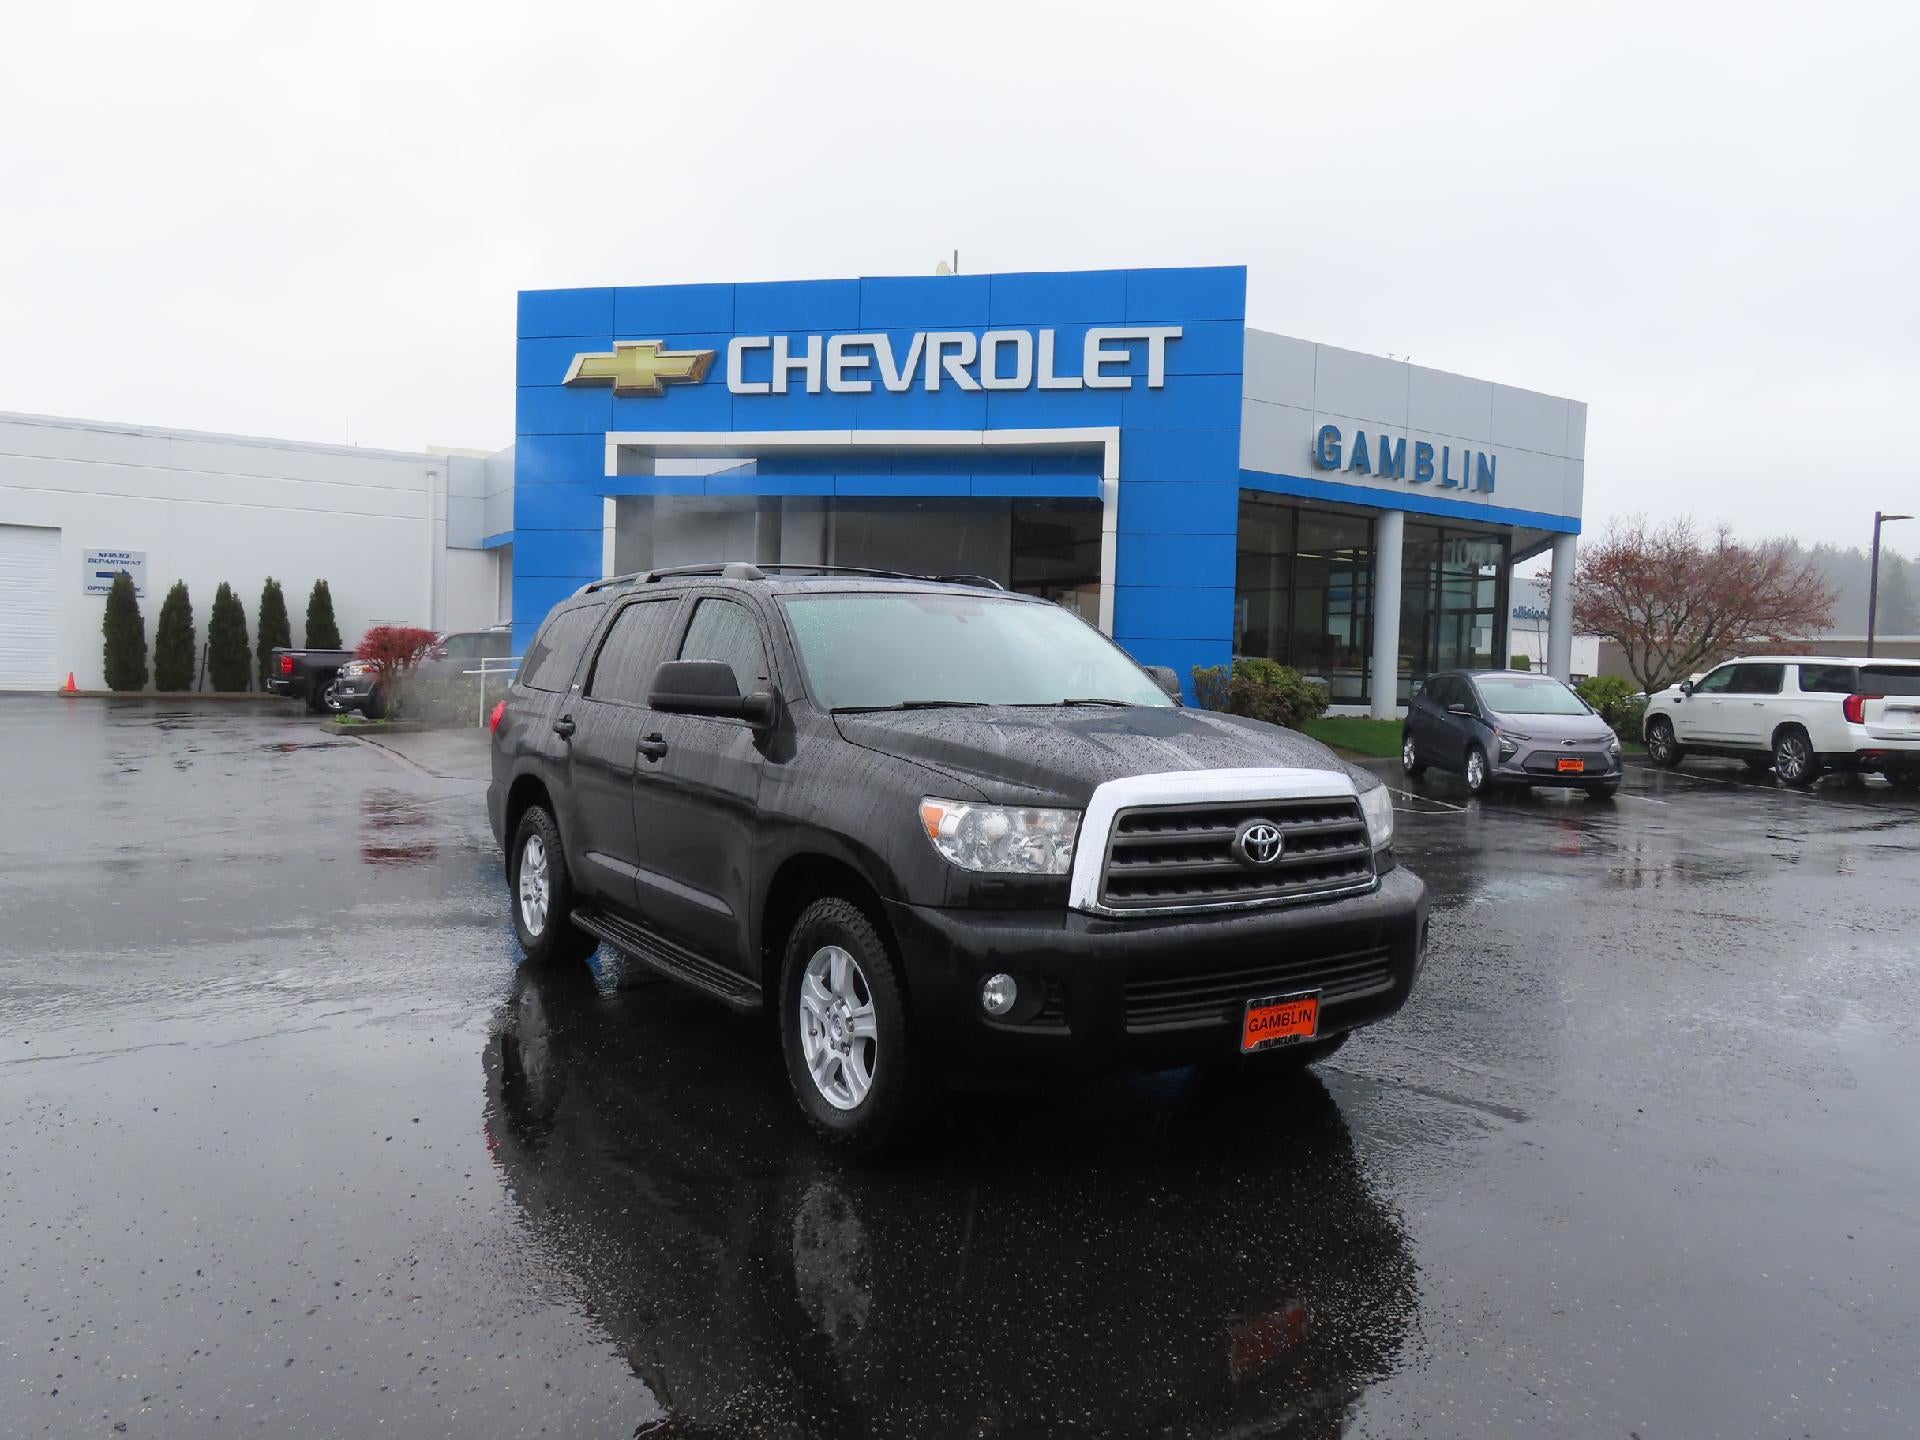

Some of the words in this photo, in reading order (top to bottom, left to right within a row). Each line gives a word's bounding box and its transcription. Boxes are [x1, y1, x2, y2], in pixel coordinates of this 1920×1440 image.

[727, 326, 1184, 394] CHEVROLET
[1315, 424, 1497, 494] GAMBLIN
[1248, 1009, 1312, 1032] GAMBLIN
